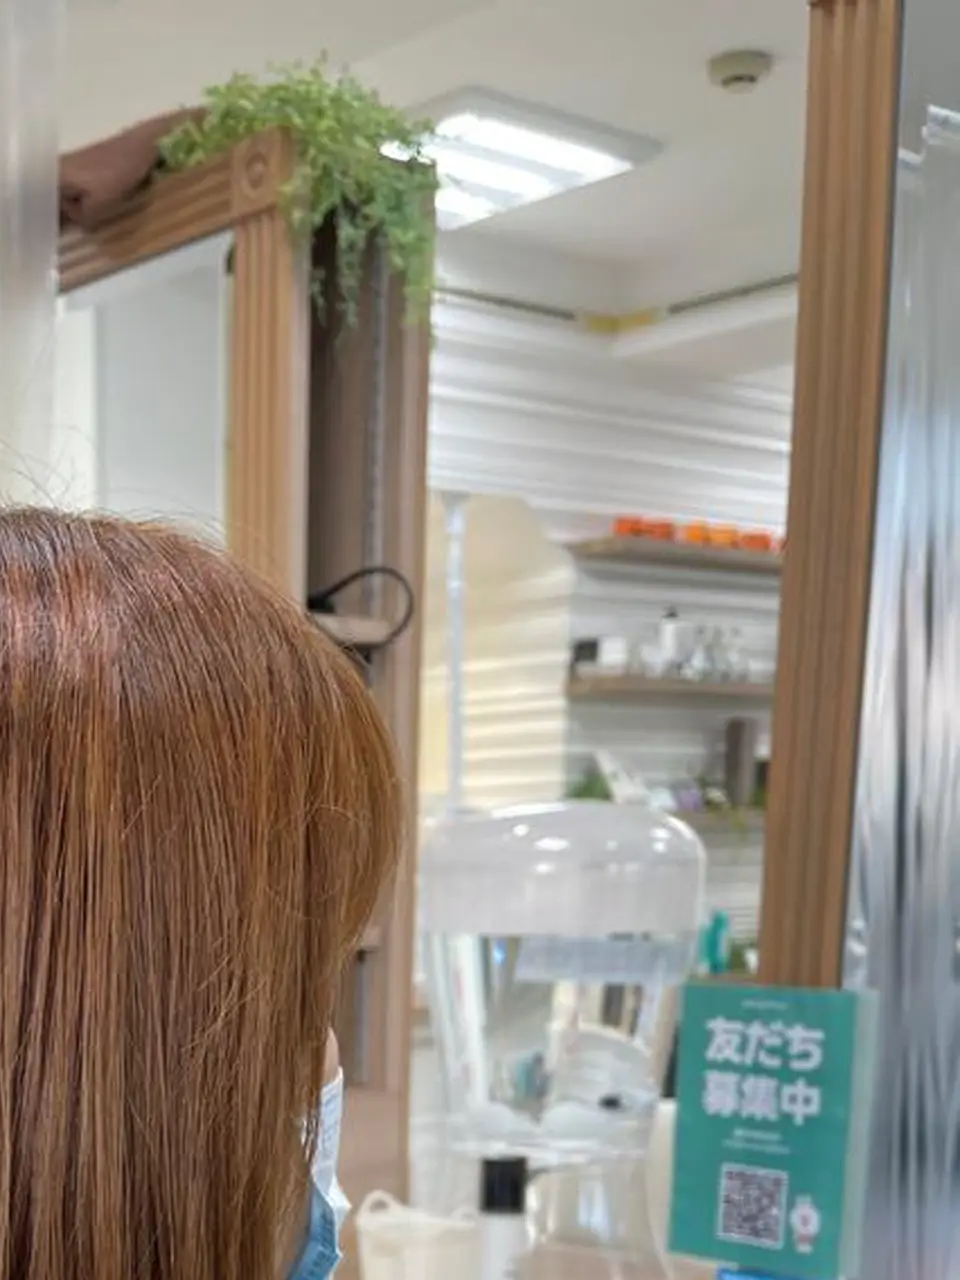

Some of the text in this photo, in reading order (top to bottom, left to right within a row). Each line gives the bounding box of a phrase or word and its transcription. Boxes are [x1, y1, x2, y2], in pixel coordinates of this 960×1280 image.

[706, 1016, 825, 1070] 友だち
[702, 1071, 821, 1125] 募集中
